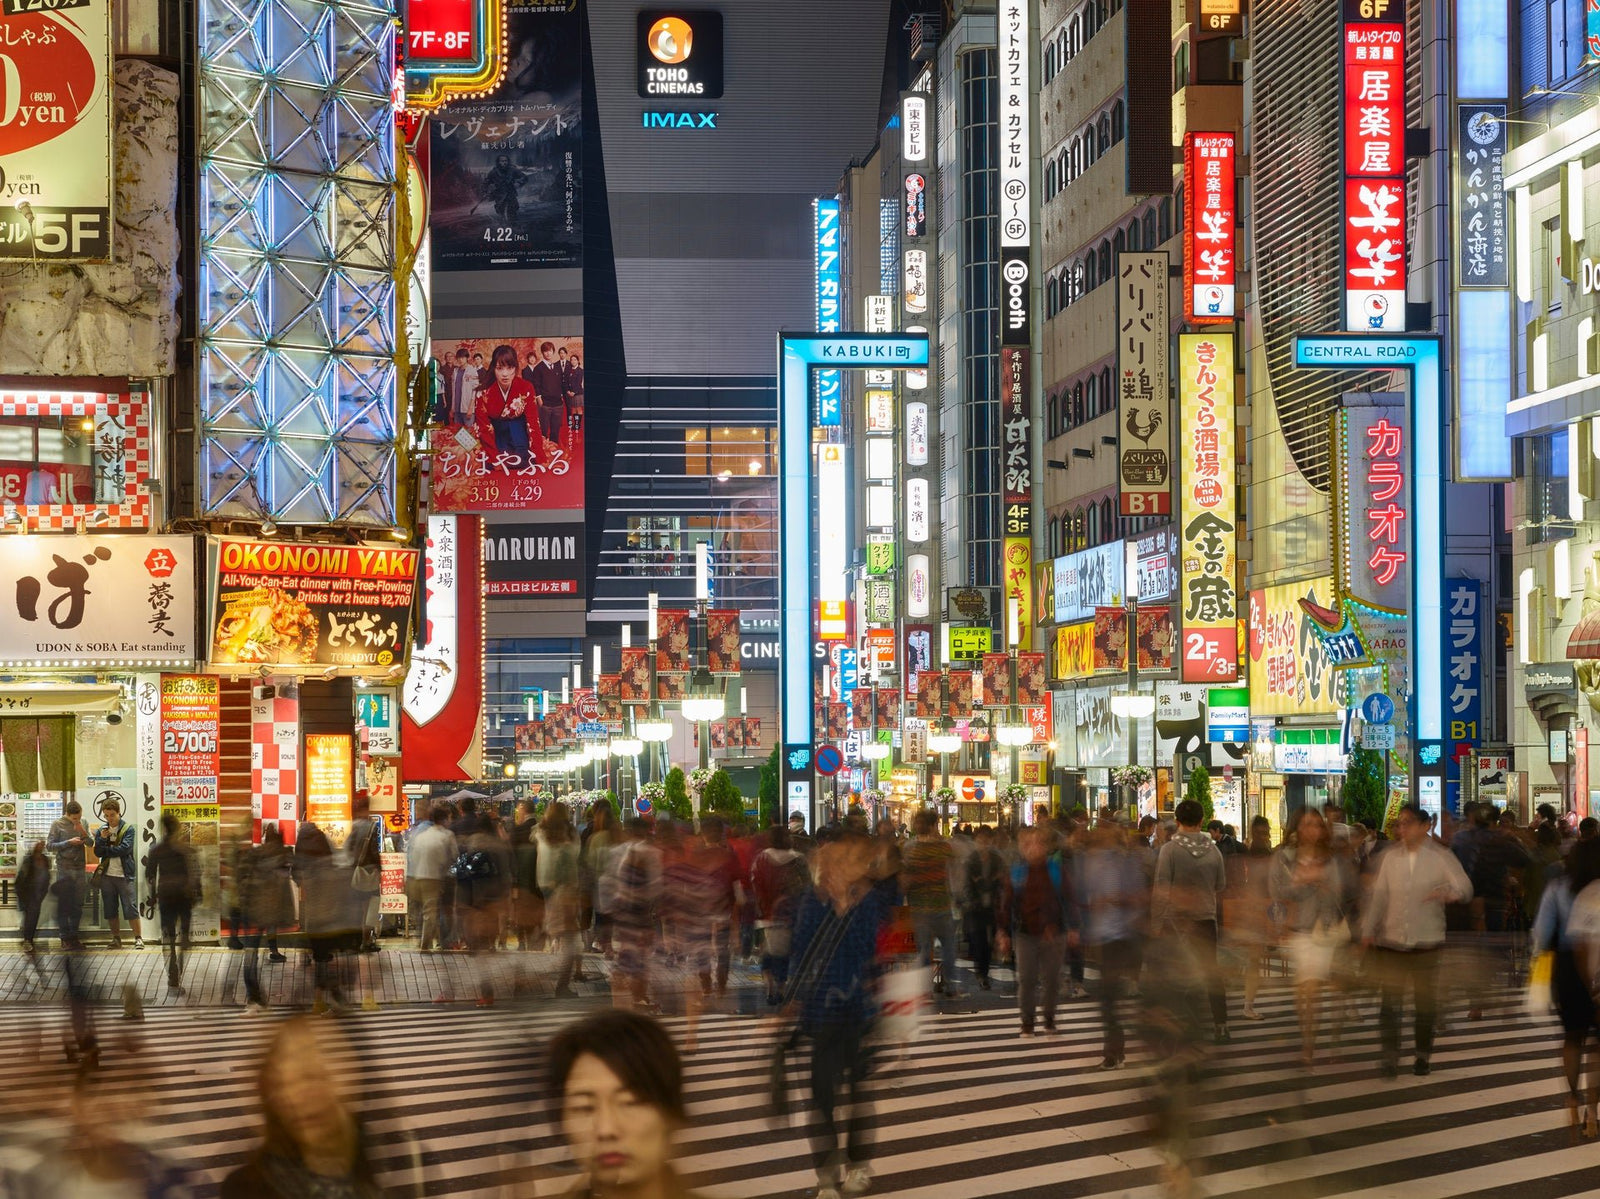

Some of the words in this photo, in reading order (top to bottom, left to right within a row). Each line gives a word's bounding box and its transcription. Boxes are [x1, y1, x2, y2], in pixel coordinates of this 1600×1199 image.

[1359, 0, 1389, 19] 6F
[1210, 15, 1231, 28] 6F
[1007, 6, 1022, 87] ネットカフェ
[1348, 31, 1401, 44] 新しいタイプの
[1356, 46, 1394, 60] 居酒屋
[647, 68, 688, 82] TOHO
[647, 82, 704, 94] CINEMAS
[448, 105, 514, 115] レオナルド・ディカプリオ
[520, 103, 557, 113] トム・ハーディ
[1008, 94, 1021, 107] &
[20, 104, 66, 126] yen
[643, 112, 717, 128] IMAX
[1359, 70, 1391, 172] 居楽屋
[439, 113, 568, 143] レヴェナント
[908, 109, 921, 155] 東京ビル
[1008, 114, 1022, 169] カプセル
[1194, 137, 1234, 147] 新しいタイプの
[1200, 148, 1228, 158] 居酒屋
[7, 181, 42, 199] yen
[1205, 161, 1222, 209] 居楽屋
[1466, 148, 1488, 277] かんかん商店
[35, 213, 100, 253] 5F
[483, 227, 513, 243] 4.22
[819, 208, 838, 271] 747
[1003, 259, 1029, 329] Booth
[1304, 346, 1372, 357] CENTRAL
[1376, 346, 1417, 357] ROAD
[1010, 351, 1022, 414] 手作り居酒屋
[1194, 342, 1219, 477] きんくら酒場
[440, 450, 570, 477] ちはやふる
[1123, 453, 1165, 464] バリバリ
[470, 486, 499, 503] 3.19
[510, 485, 542, 503] 4.29
[1198, 481, 1215, 489] KIN
[1129, 493, 1159, 514] B1
[1196, 495, 1221, 504] KURA
[1366, 418, 1407, 586] カラオケ
[1008, 505, 1029, 518] 4F
[1008, 519, 1029, 533] 3F
[437, 518, 454, 588] 大衆酒場
[484, 536, 576, 561] MARUHAN
[151, 552, 172, 572] 立
[223, 543, 349, 575] OKONOMI
[359, 549, 416, 577] YAKI
[1184, 511, 1235, 622] 金の蔵
[16, 546, 112, 629] ば
[222, 575, 299, 589] All-You-Can-Eat
[300, 577, 331, 590] dinner
[332, 579, 352, 591] with
[353, 580, 413, 594] Free-Flowing
[147, 582, 174, 637] 蕎麦
[298, 591, 328, 603] Drinks
[329, 593, 343, 604] for
[344, 595, 351, 604] 2
[353, 594, 380, 605] hours
[382, 595, 411, 608] ¥2,700
[1266, 610, 1295, 650] きんくら
[36, 643, 71, 653] UDON
[75, 643, 84, 652] &
[87, 642, 118, 652] SOBA
[121, 642, 139, 652] Eat
[141, 641, 186, 654] standing
[953, 638, 987, 649] ロード
[1186, 633, 1219, 661] 2F
[1324, 633, 1358, 659] カラオケ
[1449, 586, 1478, 714] カラオケ
[429, 646, 450, 696] やとり
[163, 677, 217, 694] お好み焼き
[163, 695, 198, 705] OKONOMI
[200, 695, 218, 705] YAKI
[1031, 708, 1047, 737] 焼肉
[1210, 712, 1247, 720] FamilyMart
[1450, 720, 1478, 740] B1
[1479, 758, 1508, 770] 探偵
[284, 802, 293, 811] 2F
